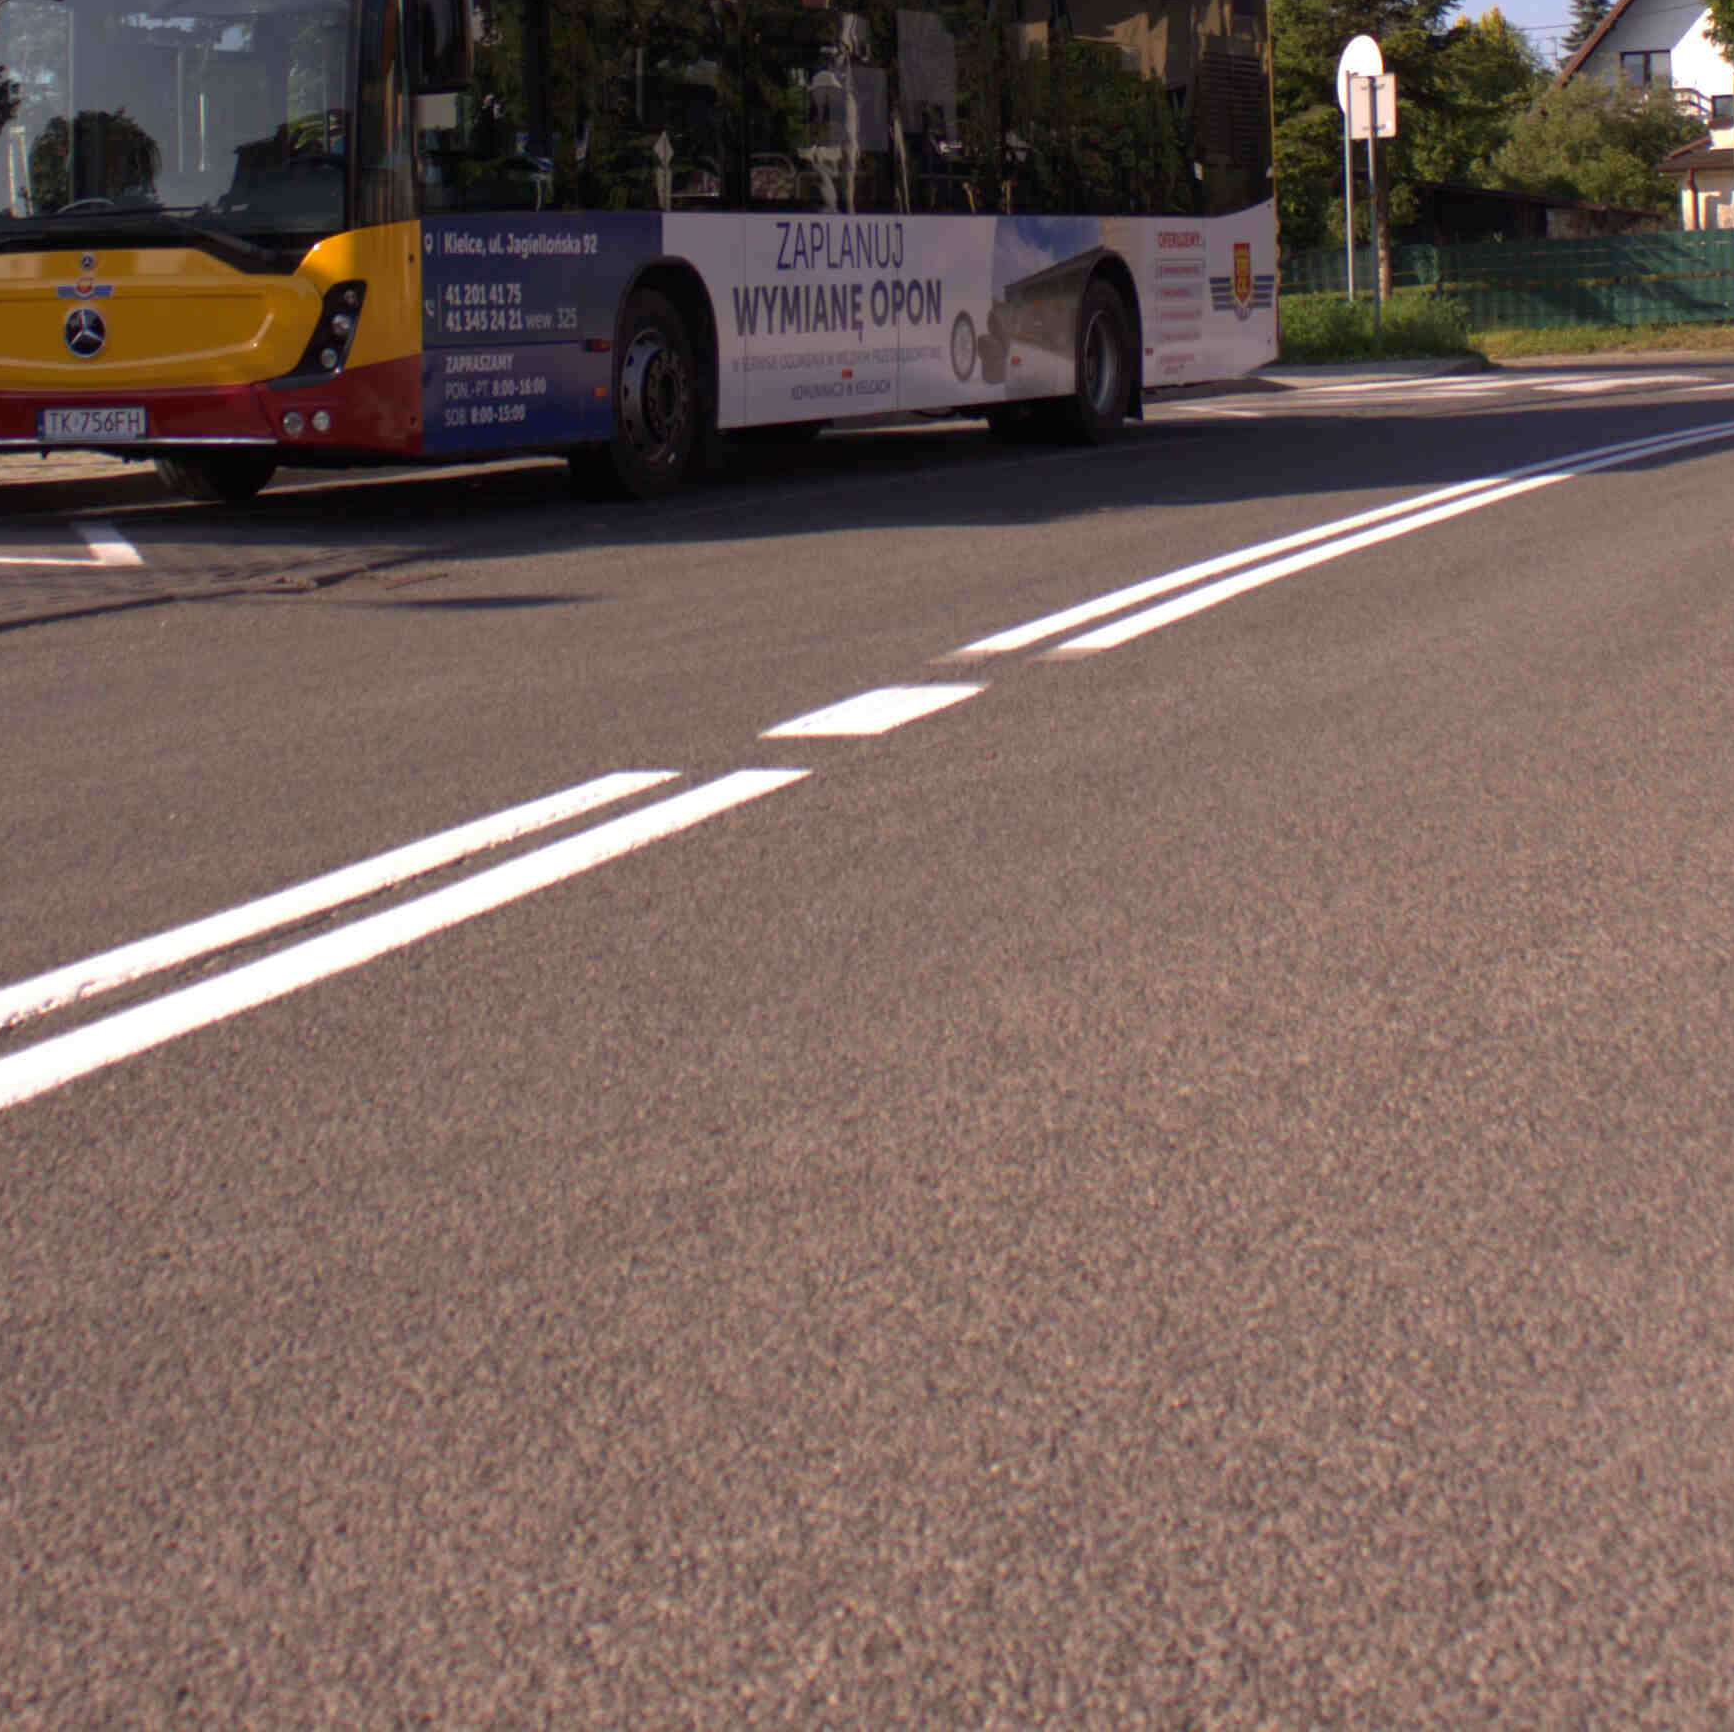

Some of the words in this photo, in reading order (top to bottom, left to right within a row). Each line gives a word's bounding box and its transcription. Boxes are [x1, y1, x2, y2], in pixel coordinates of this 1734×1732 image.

[444, 232, 486, 256] Kielce,
[488, 232, 504, 254] ul.
[506, 233, 581, 260] Jagiellońska
[583, 233, 598, 254] 92
[776, 222, 904, 271] ZAPLANUJ
[445, 284, 462, 305] 41
[464, 284, 486, 305] 201
[489, 284, 504, 305] 41
[506, 283, 522, 305] 75
[445, 310, 462, 332] 41
[464, 309, 488, 331] 345
[490, 309, 506, 331] 24
[508, 309, 524, 331] 21
[732, 282, 864, 344] WYMIANĘ
[870, 278, 942, 327] OPON
[445, 355, 515, 373] ZAPRASZAMY
[50, 411, 73, 433] TK
[82, 410, 141, 433] 756FH
